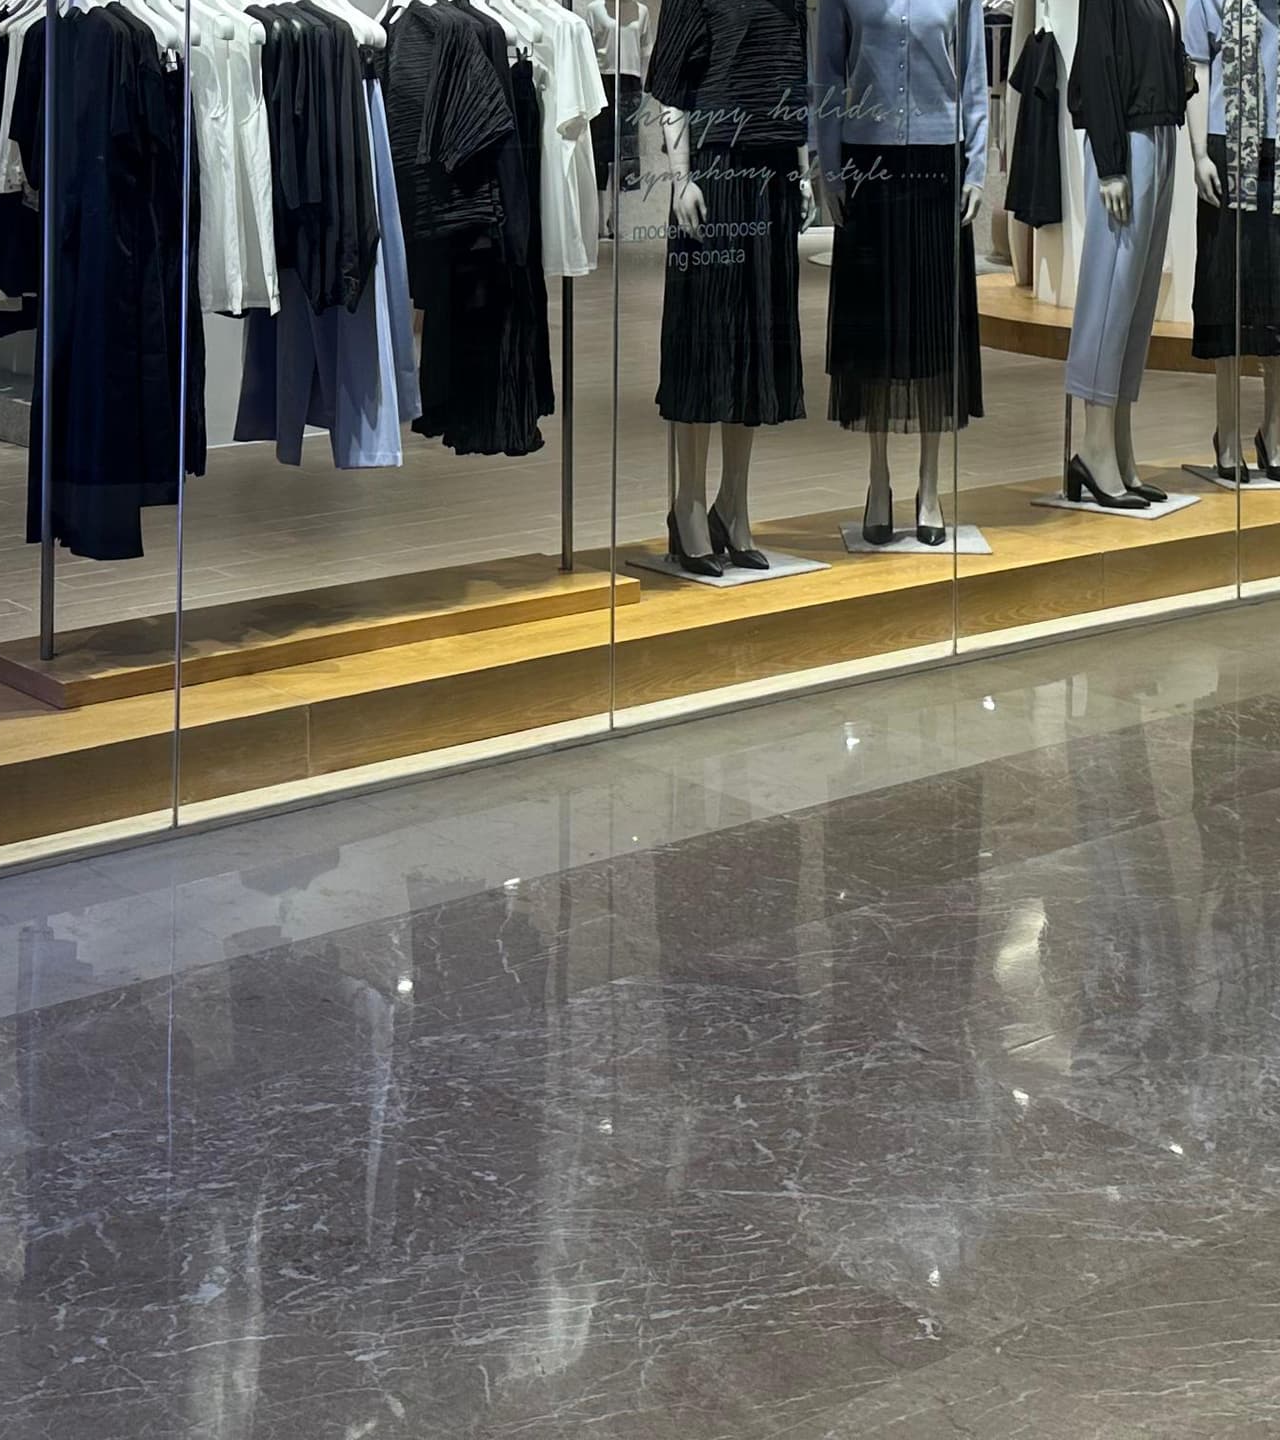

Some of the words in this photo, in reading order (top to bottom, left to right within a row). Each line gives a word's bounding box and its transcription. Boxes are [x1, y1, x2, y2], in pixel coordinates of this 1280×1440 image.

[625, 92, 753, 150] happy
[624, 155, 777, 202] symphony
[825, 156, 895, 199] style
[696, 220, 773, 242] composer
[692, 247, 746, 264] sonata
